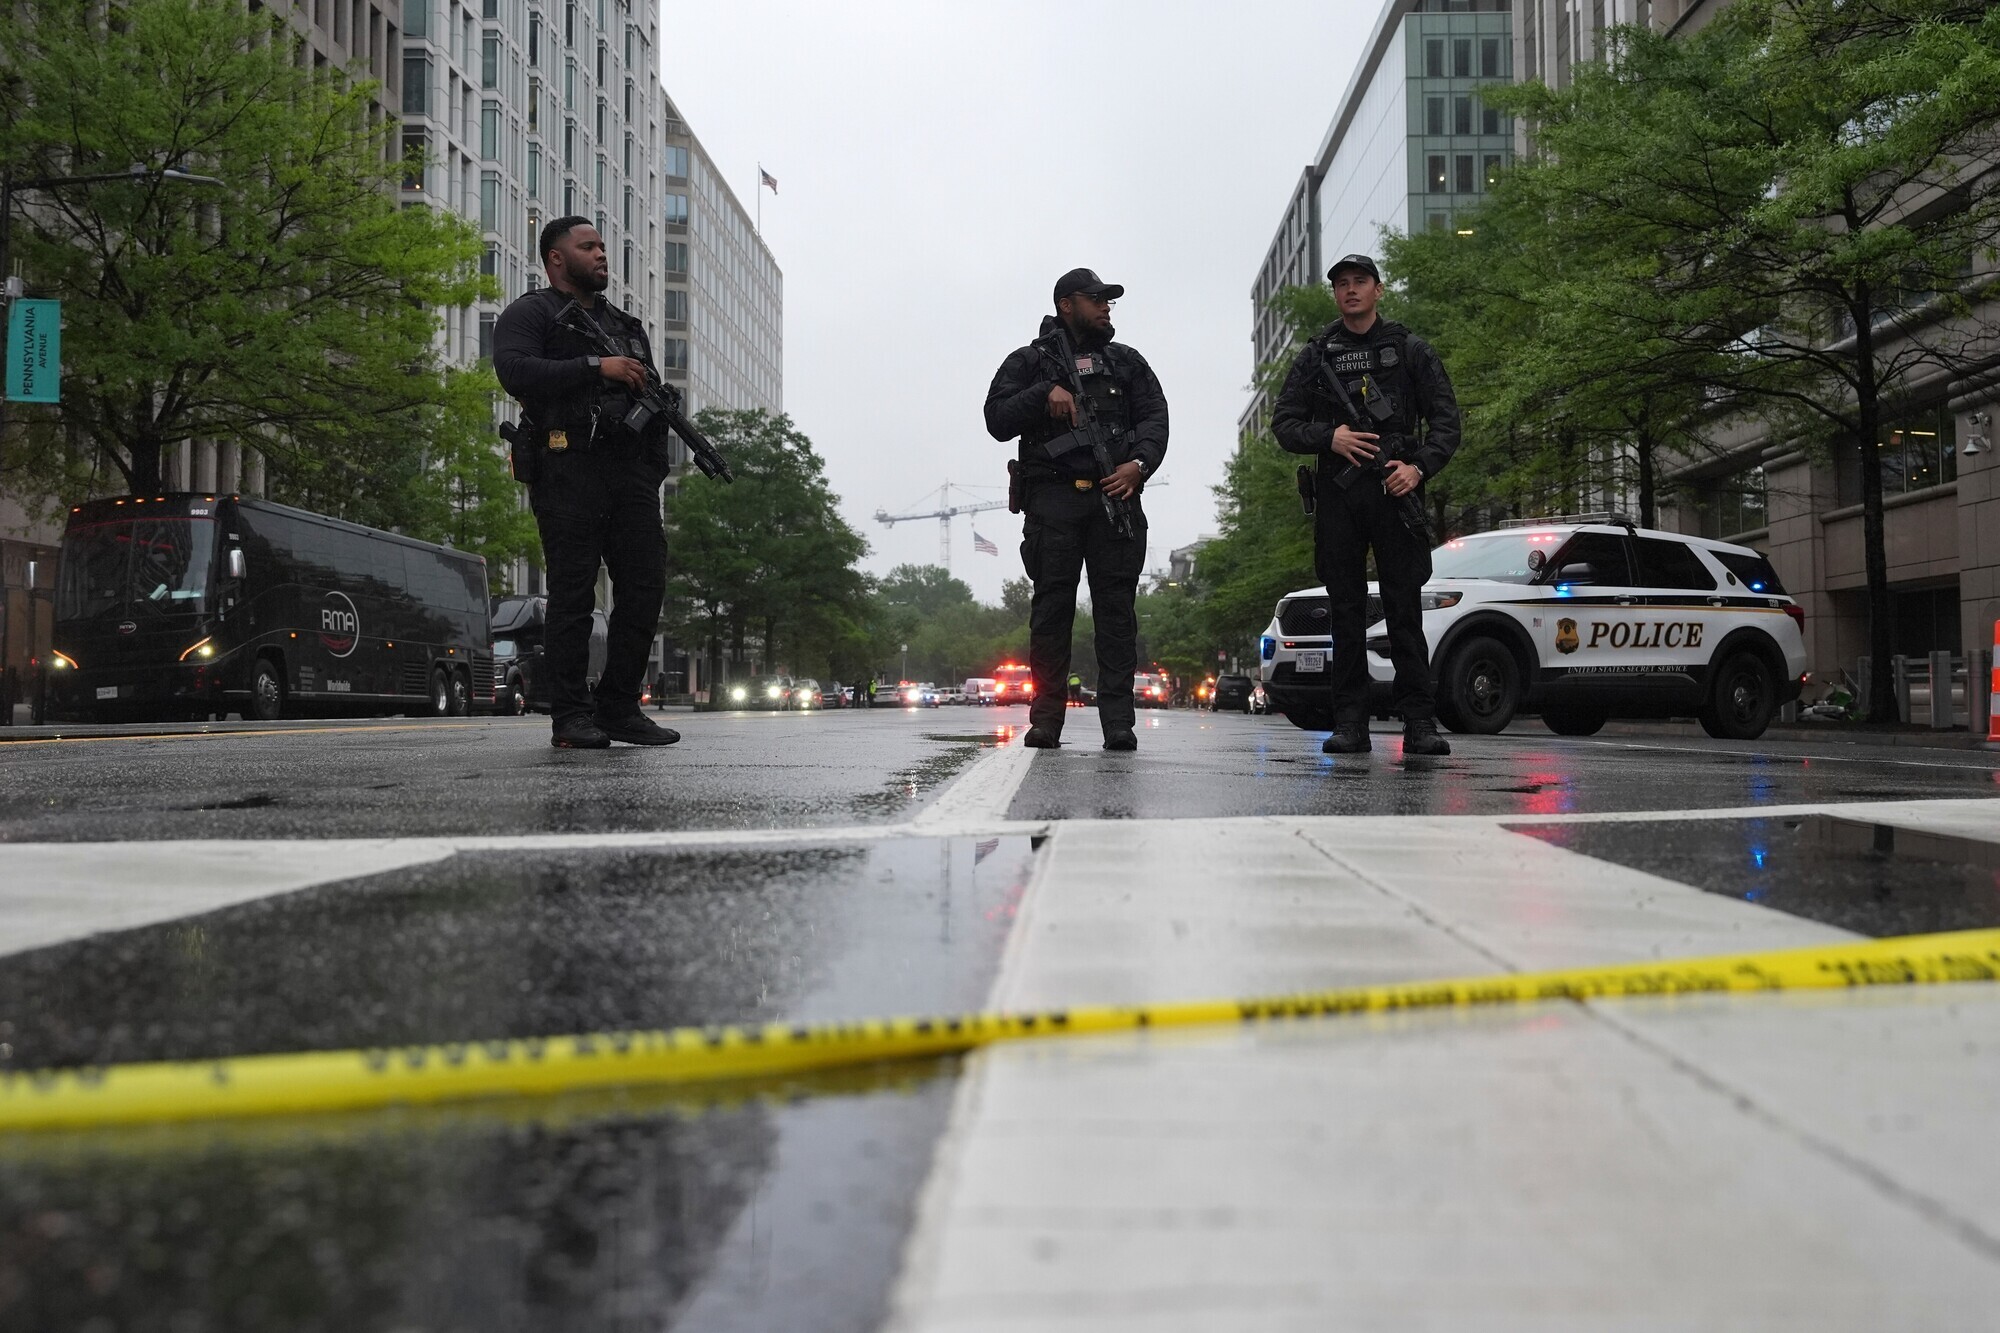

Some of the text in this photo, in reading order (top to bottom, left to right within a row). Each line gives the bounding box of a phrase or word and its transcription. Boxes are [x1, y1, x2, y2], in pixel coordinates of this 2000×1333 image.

[23, 306, 35, 396] PENNSYLVANIA
[39, 333, 47, 368] AVENUE
[1336, 352, 1369, 362] SECRET
[1335, 361, 1372, 372] SERVICE
[190, 508, 209, 516] 9903
[321, 609, 355, 632] RMA
[1586, 622, 1703, 648] POLICE
[1567, 666, 1598, 674] UNITED
[1626, 665, 1655, 673] SECRET
